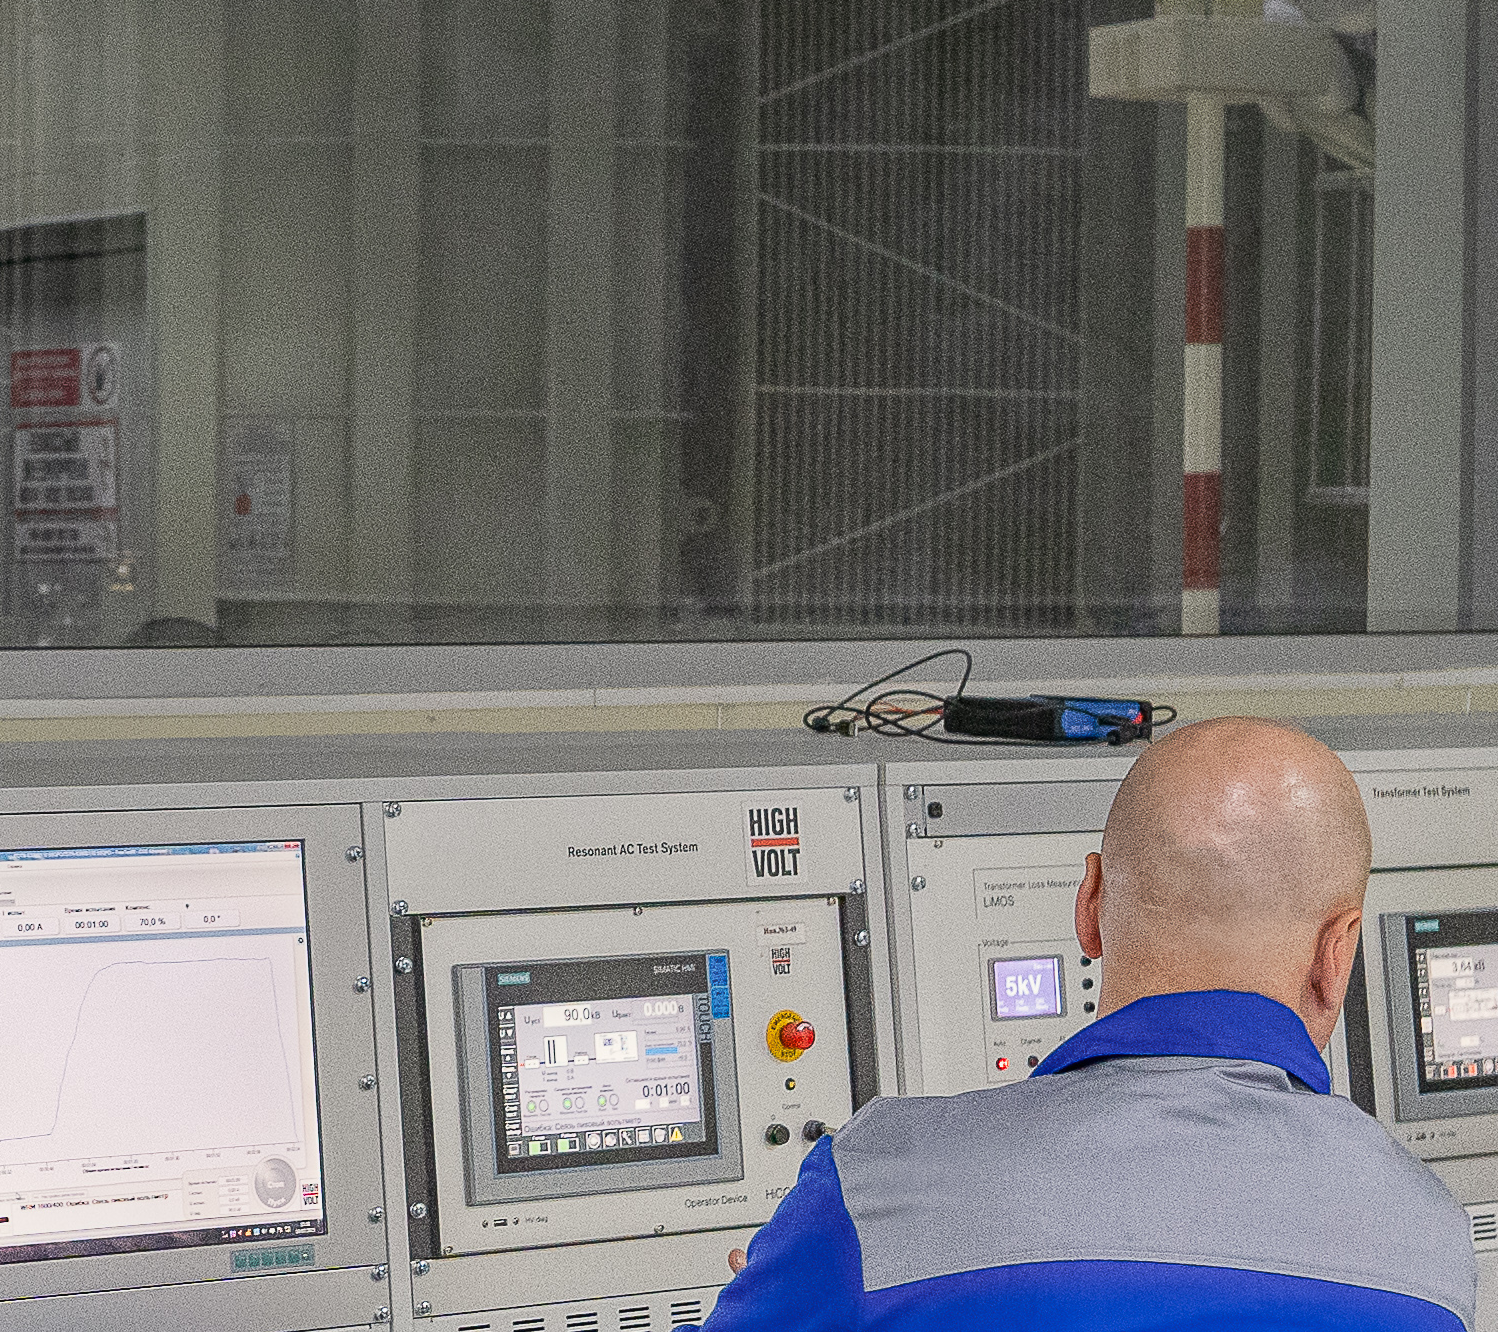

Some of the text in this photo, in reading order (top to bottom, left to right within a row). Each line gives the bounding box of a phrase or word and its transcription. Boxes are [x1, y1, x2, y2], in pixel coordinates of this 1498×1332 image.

[1373, 785, 1470, 798] Transformer Test System
[749, 808, 799, 836] HIGH
[568, 843, 698, 857] Resonant AC Test System
[752, 849, 800, 878] VOLT
[1028, 881, 1044, 889] Loss
[982, 939, 1009, 947] Voltage
[772, 948, 791, 959] HIGH
[773, 964, 791, 975] VOLT
[1006, 974, 1042, 997] 5kV
[564, 1008, 590, 1022] 90,0
[698, 996, 711, 1043] TOUCH
[642, 1082, 690, 1098] 0:01:00
[302, 1183, 319, 1193] HIGH
[303, 1195, 319, 1206] VOLT
[685, 1195, 748, 1208] Operator Device
